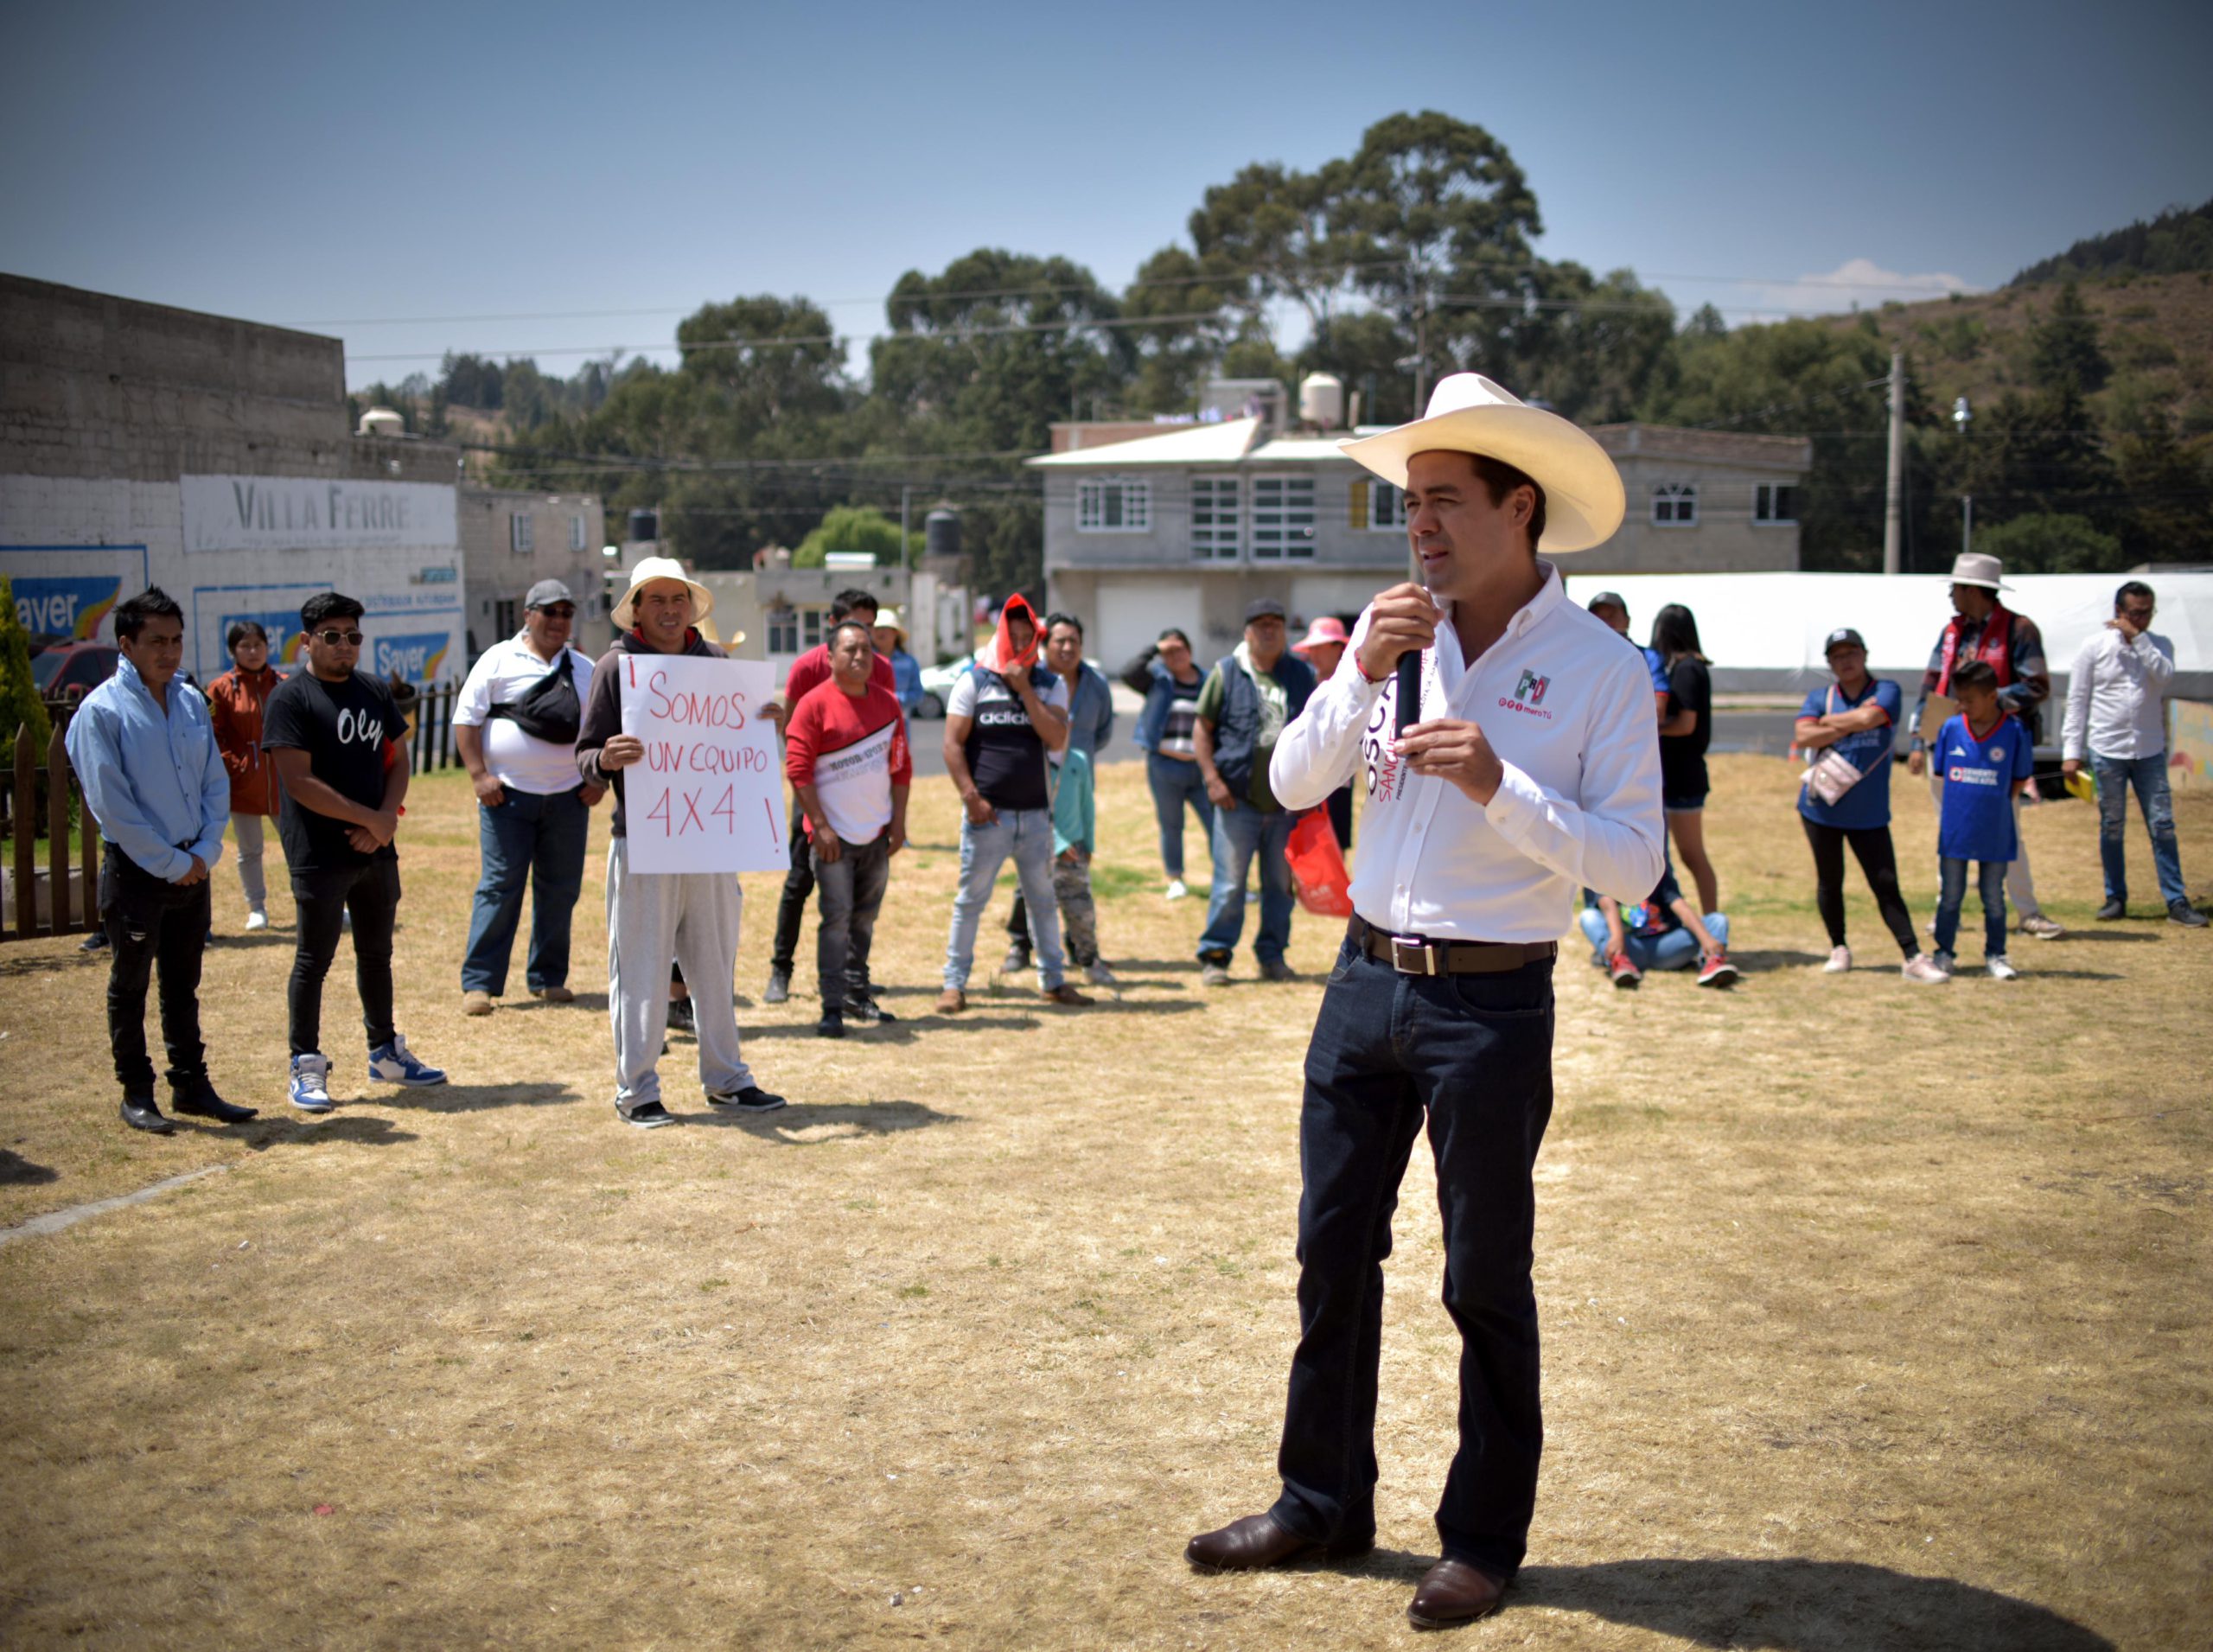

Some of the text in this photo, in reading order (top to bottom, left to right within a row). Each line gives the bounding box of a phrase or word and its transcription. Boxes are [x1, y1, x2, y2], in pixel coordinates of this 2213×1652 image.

[233, 481, 410, 530] VILLA FERRE
[16, 593, 79, 634] ayer
[378, 641, 428, 685] Sayer
[649, 671, 746, 730] SOMOS
[979, 711, 1029, 724] adid
[337, 707, 384, 751] Oly
[1361, 673, 1399, 796] OSCA
[648, 742, 768, 775] UN EQUIPO
[1380, 718, 1399, 803] SÁNCH
